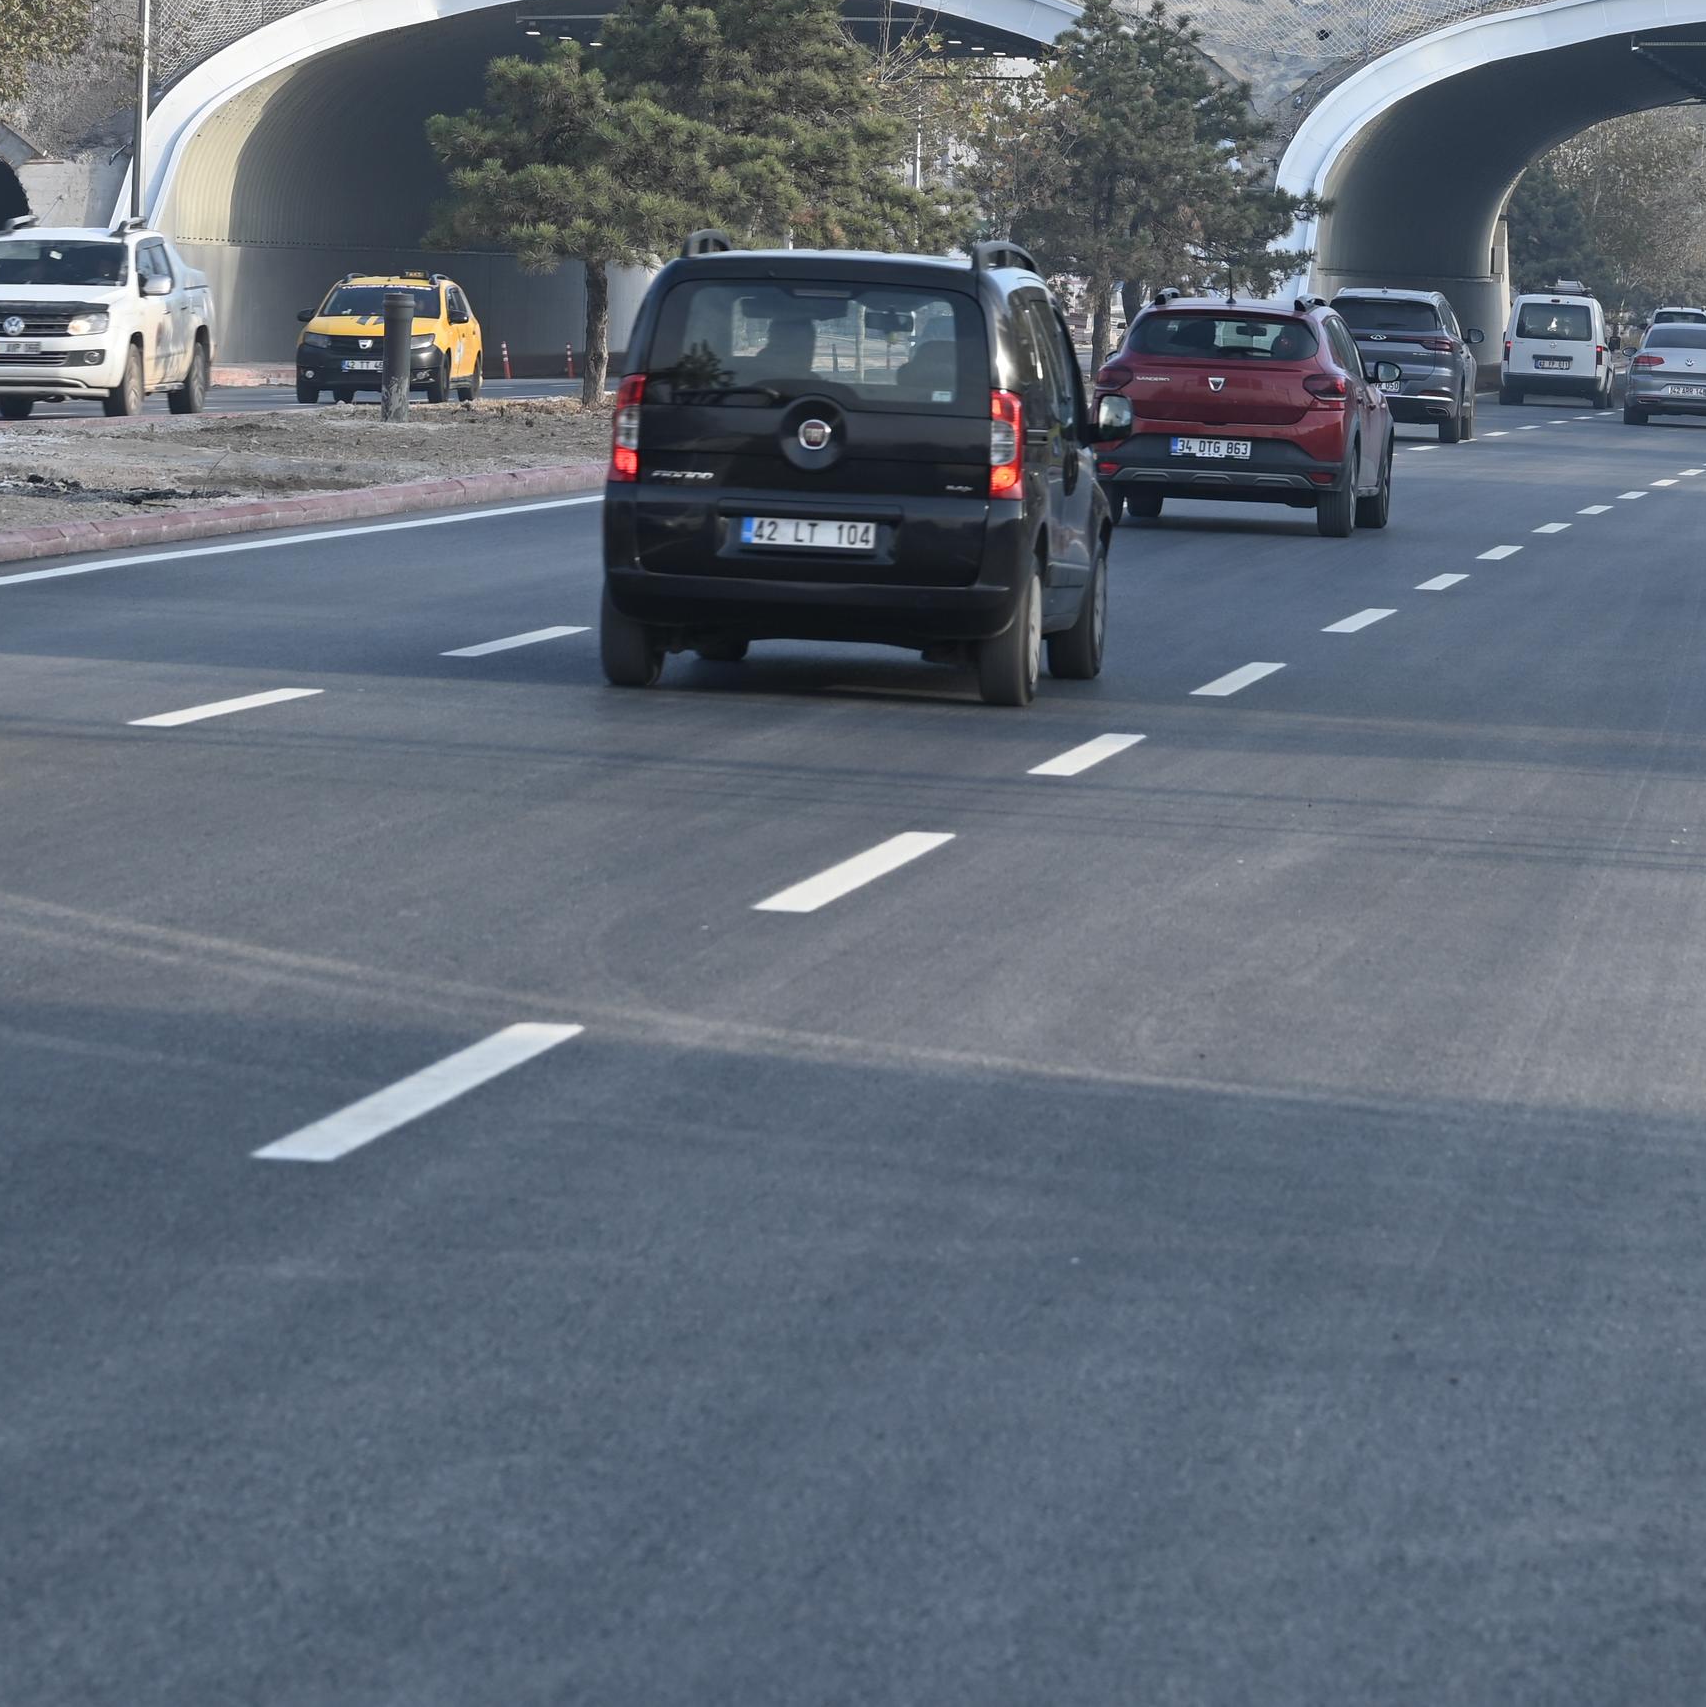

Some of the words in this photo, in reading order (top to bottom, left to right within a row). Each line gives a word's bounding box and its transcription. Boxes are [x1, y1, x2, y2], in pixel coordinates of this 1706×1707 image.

[1177, 440, 1192, 453] 34
[1199, 440, 1221, 454] DTG
[1226, 442, 1249, 455] 863
[753, 521, 778, 541] 42
[794, 522, 818, 543] LT
[837, 524, 872, 546] 104
